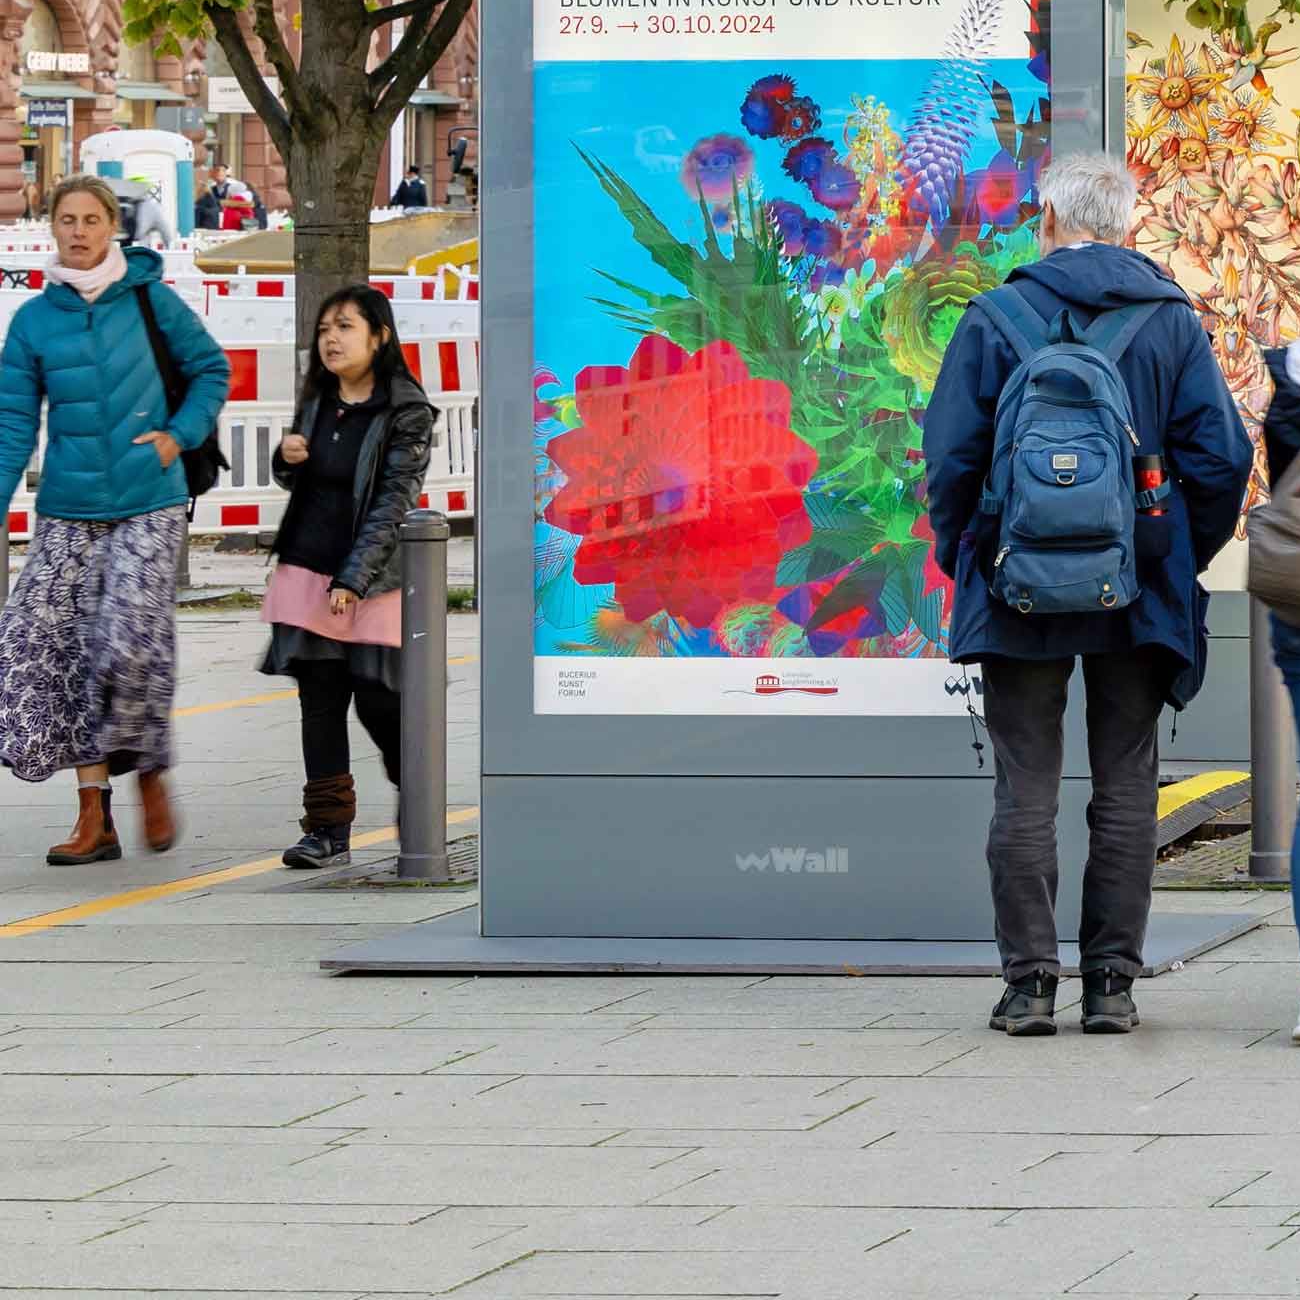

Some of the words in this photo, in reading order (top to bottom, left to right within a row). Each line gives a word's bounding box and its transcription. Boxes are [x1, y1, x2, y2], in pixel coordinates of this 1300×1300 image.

[559, 15, 608, 35] 27.9.
[647, 14, 776, 35] 30.10.2024
[27, 52, 57, 71] GERRY
[559, 670, 597, 679] BUCERIUS
[558, 680, 585, 688] KUNST
[558, 689, 586, 697] FORUM
